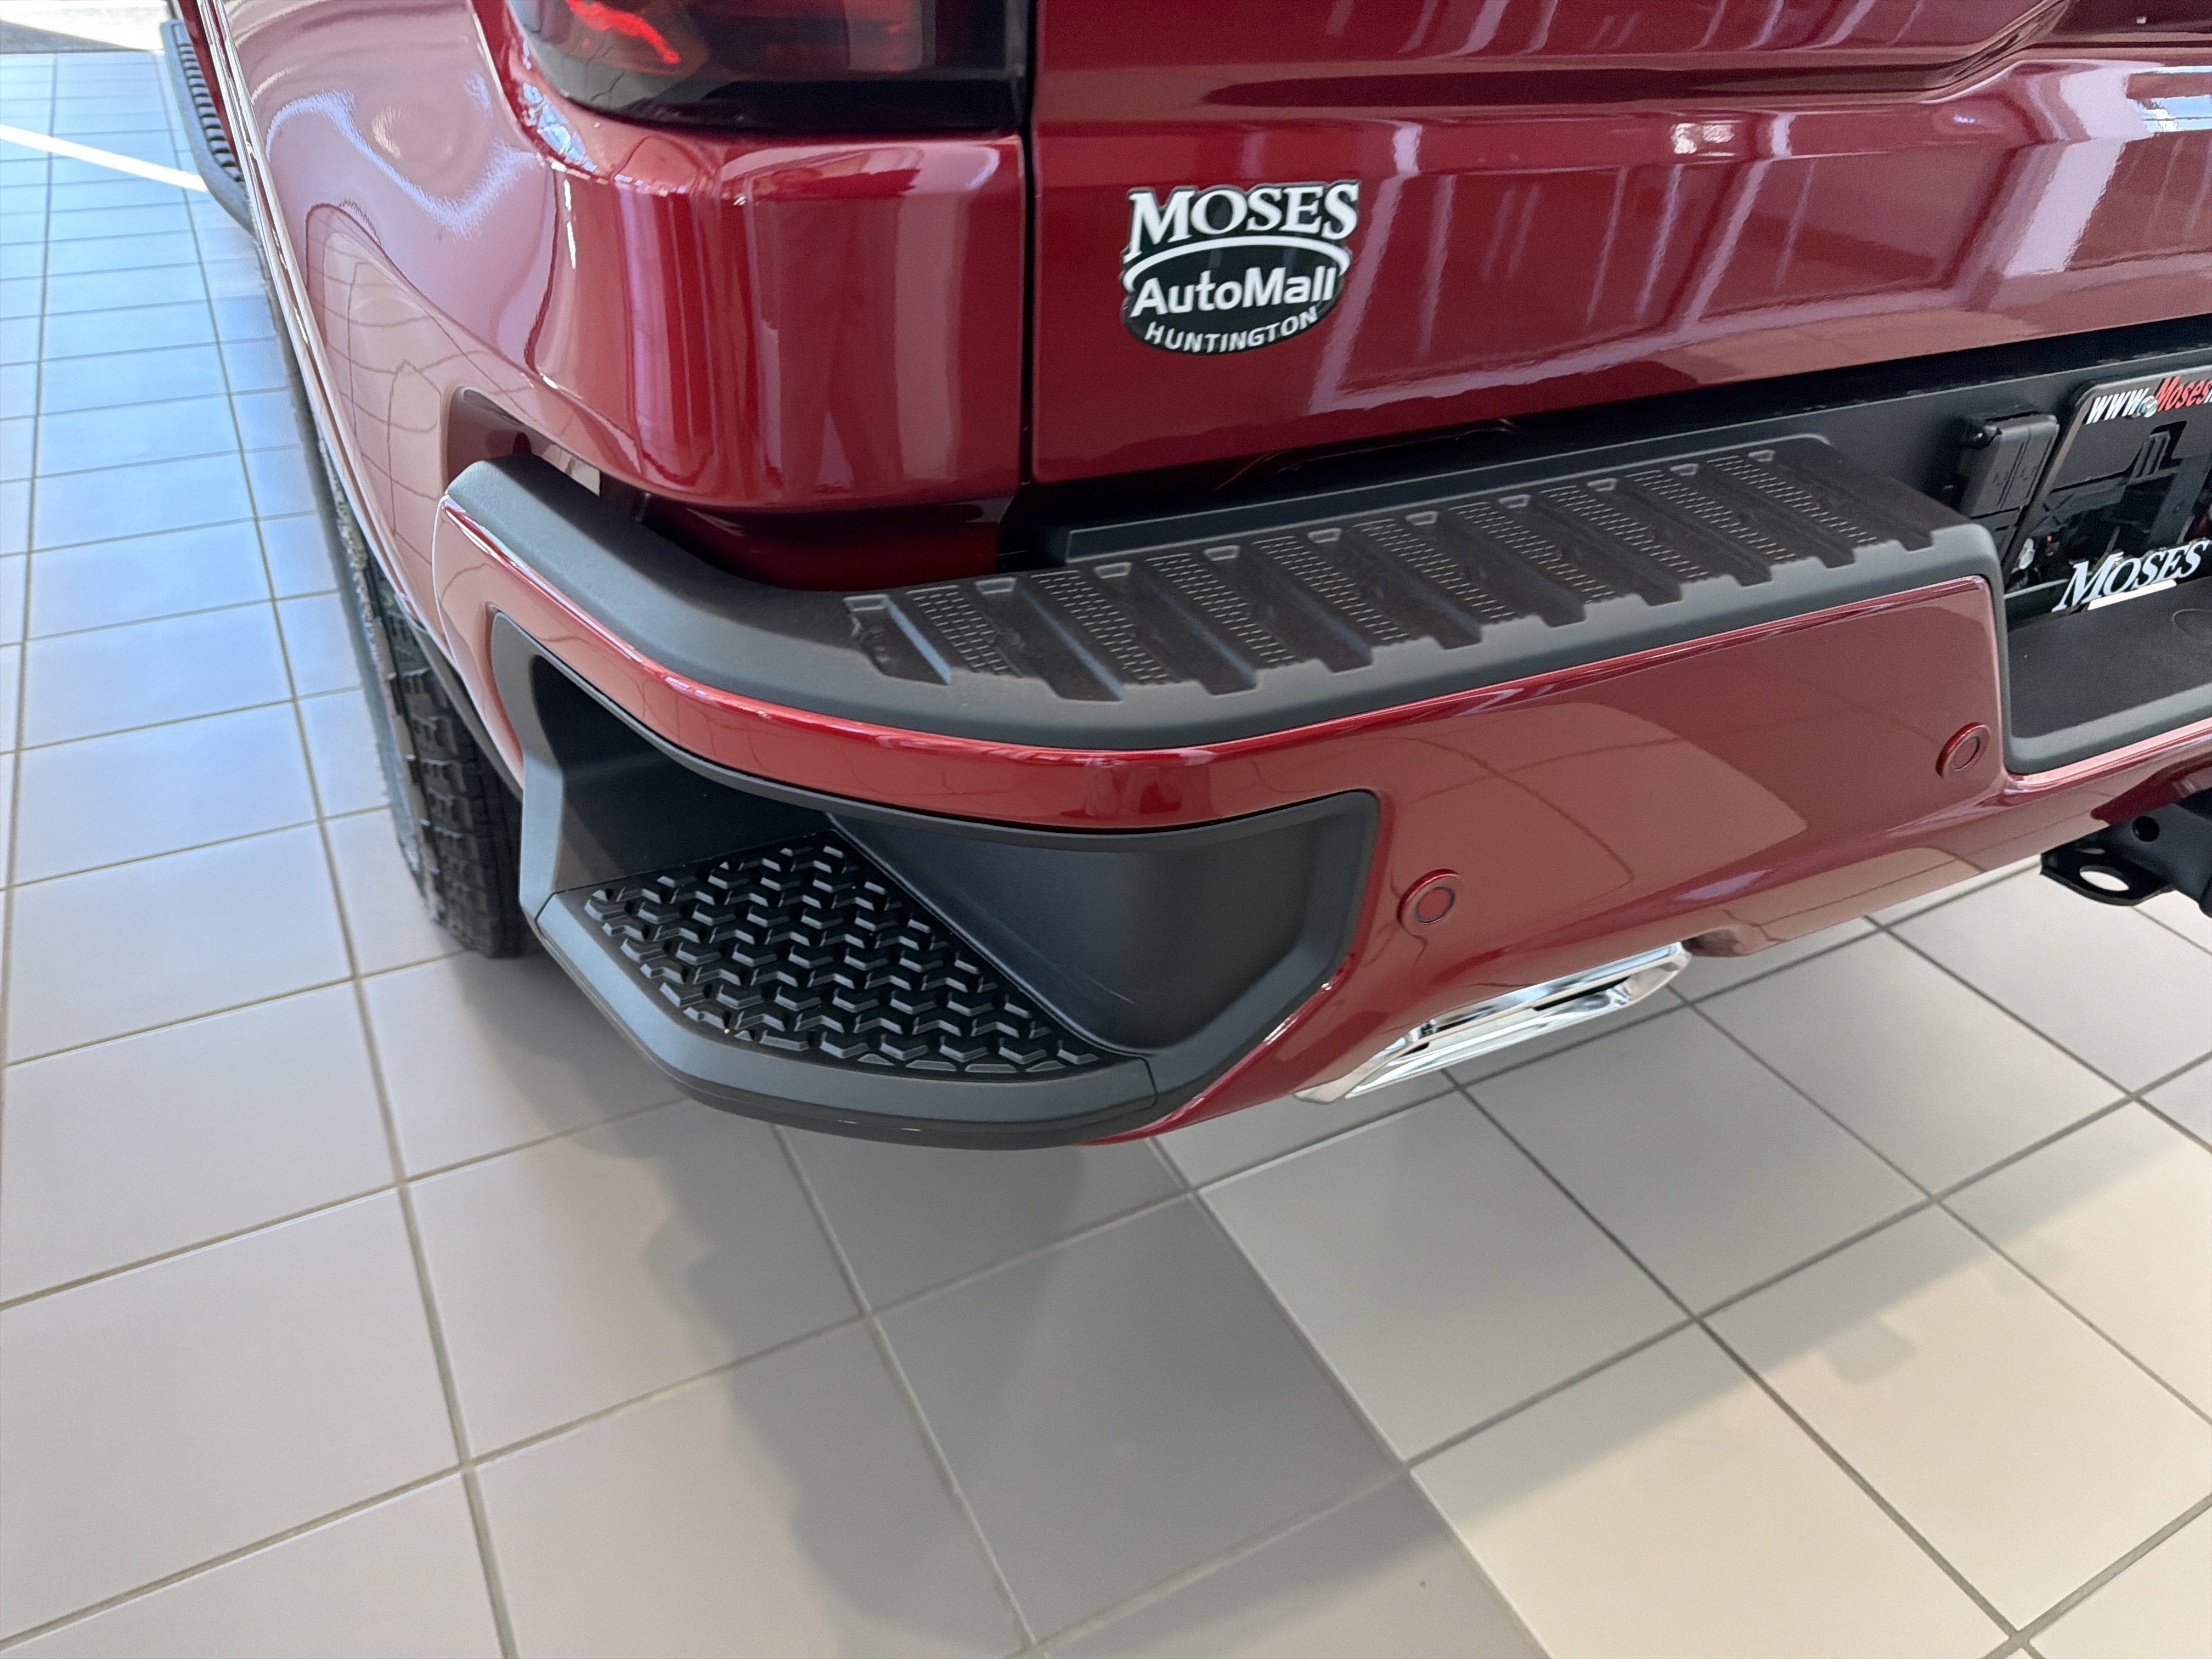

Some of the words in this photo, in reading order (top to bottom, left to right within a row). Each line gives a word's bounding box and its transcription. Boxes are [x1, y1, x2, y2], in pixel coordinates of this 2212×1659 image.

[1123, 183, 1359, 263] MOSES
[1130, 266, 1337, 318] AutoMall
[1144, 305, 1318, 353] HUNTINGTON
[2051, 540, 2210, 613] MOSES
